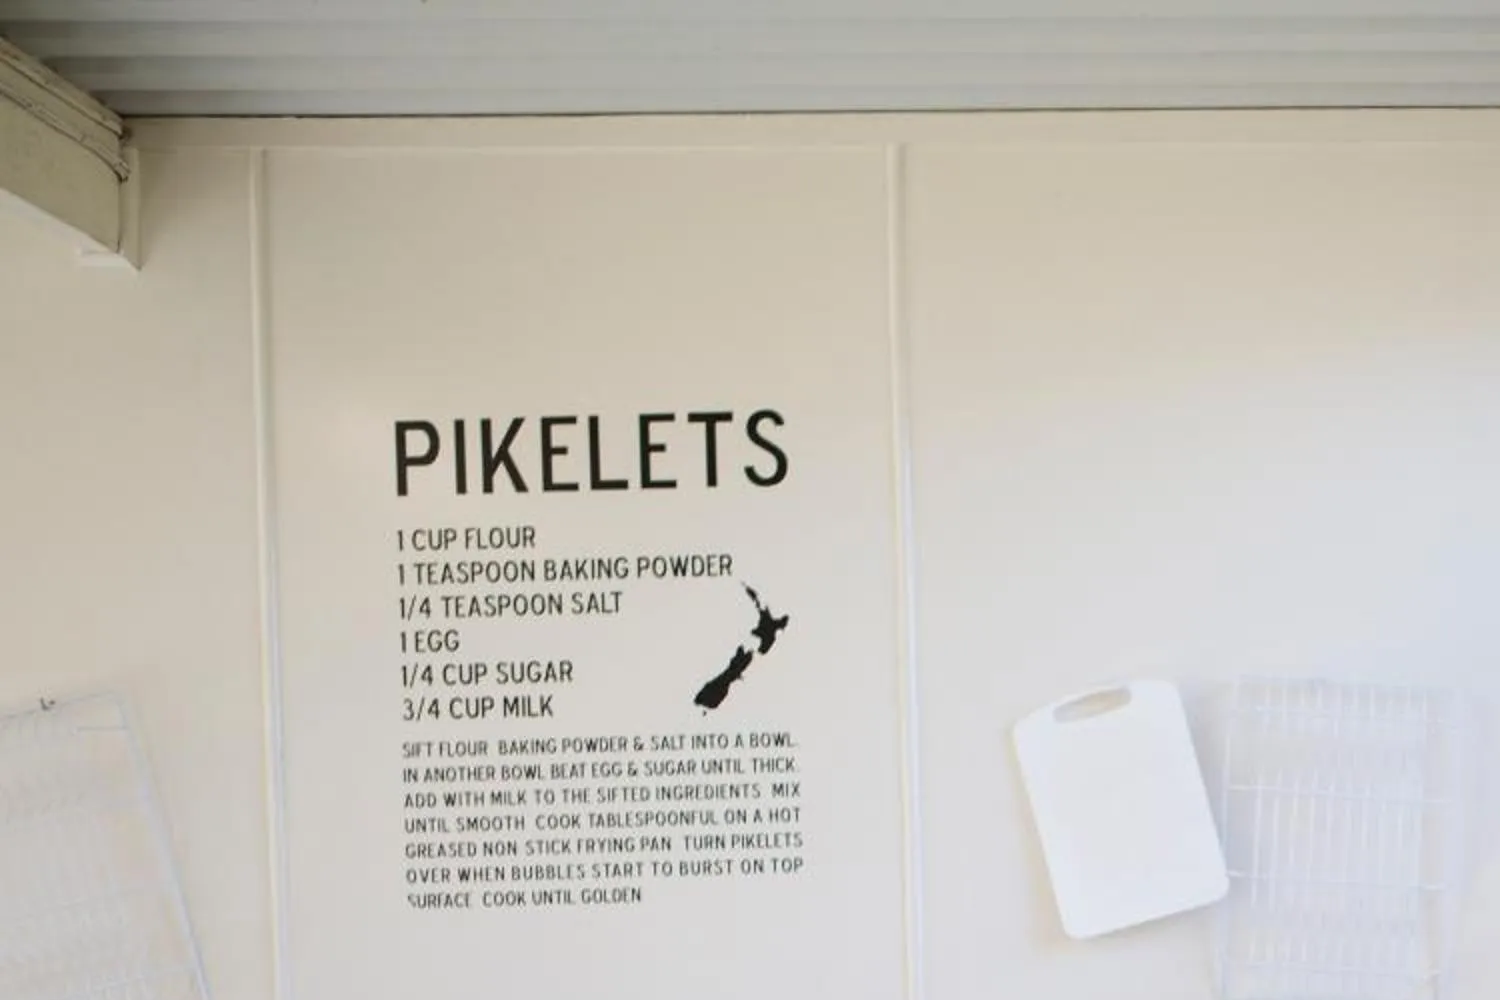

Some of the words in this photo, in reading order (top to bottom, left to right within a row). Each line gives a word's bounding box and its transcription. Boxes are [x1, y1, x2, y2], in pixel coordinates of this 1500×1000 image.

[393, 408, 790, 498] PIKELETS
[396, 529, 405, 553] 1
[410, 527, 458, 553] CUP
[463, 525, 536, 551] FLOUR
[397, 563, 406, 587] 1
[412, 559, 536, 586] TEASPOON
[543, 555, 630, 583] BAKING
[635, 553, 733, 580] POWDER
[399, 594, 433, 622] 1/4
[440, 592, 564, 619] TEASPOON
[570, 590, 624, 616] SALT
[399, 630, 407, 654] 1
[413, 628, 461, 654] EGG
[400, 661, 434, 689] 1/4
[441, 661, 489, 687] CUP
[495, 659, 574, 686] SUGAR
[402, 696, 441, 722] 3/4
[448, 695, 496, 721] CUP
[502, 693, 554, 719] MILK
[401, 740, 434, 759] SIFT
[497, 737, 558, 757] BAKING
[561, 735, 629, 754] POWDER
[632, 735, 645, 753] &
[650, 733, 686, 752] SALT
[691, 732, 729, 751] INTO
[733, 732, 745, 749] A
[402, 767, 419, 784] IN
[423, 764, 497, 784] ANOTHER
[500, 763, 545, 782] BOWL
[550, 761, 586, 780] BEAT
[591, 760, 623, 779] EGG
[626, 760, 639, 778] &
[643, 758, 697, 777] SUGAR
[700, 757, 745, 775] UNTIL
[403, 791, 438, 810] ADD
[442, 790, 485, 808] WITH
[489, 789, 527, 807] MILK
[534, 788, 556, 805] TO
[562, 787, 590, 804] THE
[596, 786, 651, 803] SIFTED
[771, 781, 801, 799] MIX
[404, 816, 450, 835] UNTIL
[535, 813, 581, 831] COOK
[588, 809, 718, 829] TABLESPOONFUL
[723, 808, 748, 825] ON
[752, 808, 764, 824] A
[768, 806, 801, 824] HOT
[404, 841, 478, 860] GREASED
[576, 836, 636, 854] FRYING
[683, 834, 726, 852] TURN
[730, 831, 804, 850] PIKELETS
[405, 867, 451, 885] OVER
[457, 865, 506, 884] WHEN
[510, 863, 586, 882] BUBBLES
[591, 861, 644, 880] START
[651, 860, 674, 878] TO
[678, 858, 734, 877] BURST
[739, 858, 765, 876] ON
[770, 856, 804, 874] TOP
[481, 890, 527, 908] COOK
[531, 888, 576, 907] UNTIL
[580, 886, 642, 905] GOLDEN
